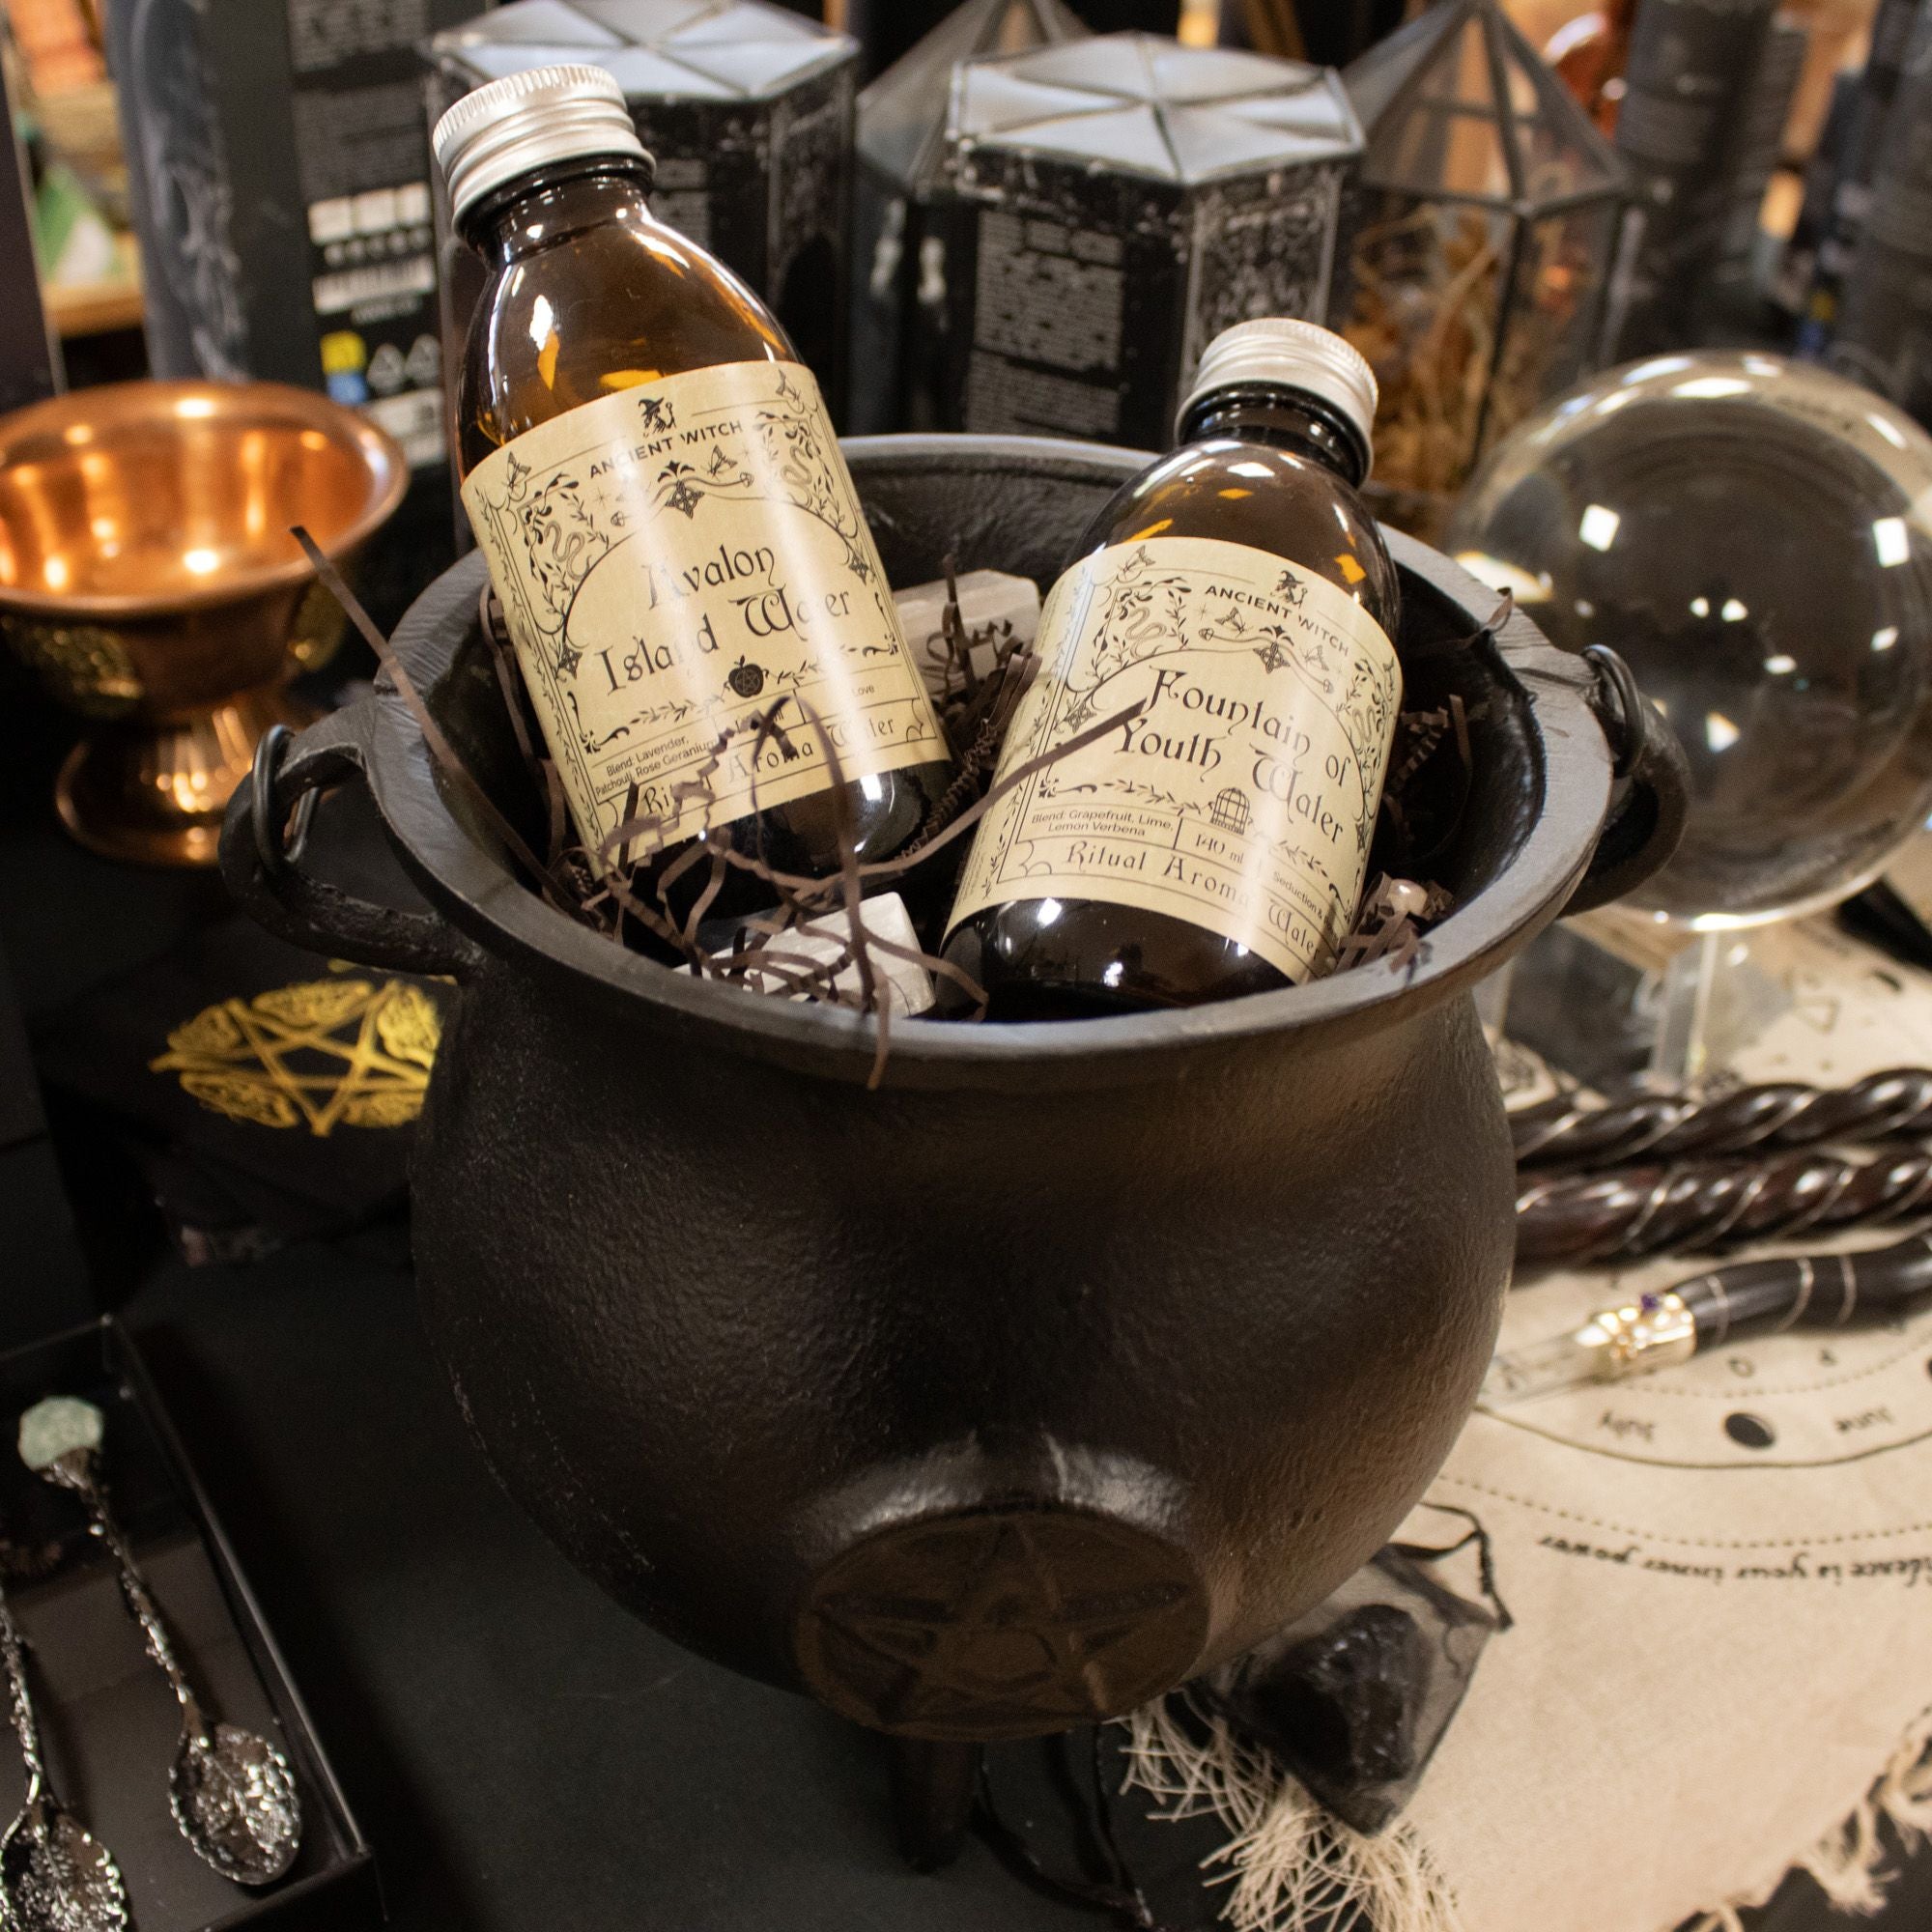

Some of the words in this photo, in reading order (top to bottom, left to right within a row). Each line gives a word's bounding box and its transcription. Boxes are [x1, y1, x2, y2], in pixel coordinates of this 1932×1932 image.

[680, 420, 744, 444] WITCH
[641, 544, 775, 610] Avalon
[594, 612, 719, 696] Islad
[727, 583, 850, 641] Waer
[1205, 585, 1293, 619] ANCIENT
[1298, 615, 1349, 657] WITCH
[1141, 665, 1311, 766] Fountain
[606, 757, 634, 777] Blend:
[636, 736, 690, 763] Lavender,
[636, 762, 662, 778] Rose
[728, 742, 814, 783] Aroa
[1114, 718, 1228, 782] Youth
[1249, 743, 1343, 843] Water
[1032, 811, 1065, 824] Blend:
[1069, 810, 1134, 824] Grapefruit,
[1139, 814, 1175, 831] Lime,
[1048, 822, 1089, 833] Lemon
[1093, 821, 1146, 837] Verbena
[1195, 834, 1226, 854] 140
[1230, 852, 1245, 865] ml
[1064, 840, 1147, 872] Ritual
[1268, 897, 1321, 960] Water
[1273, 871, 1317, 914] Seduction
[1737, 1551, 1809, 1579] your
